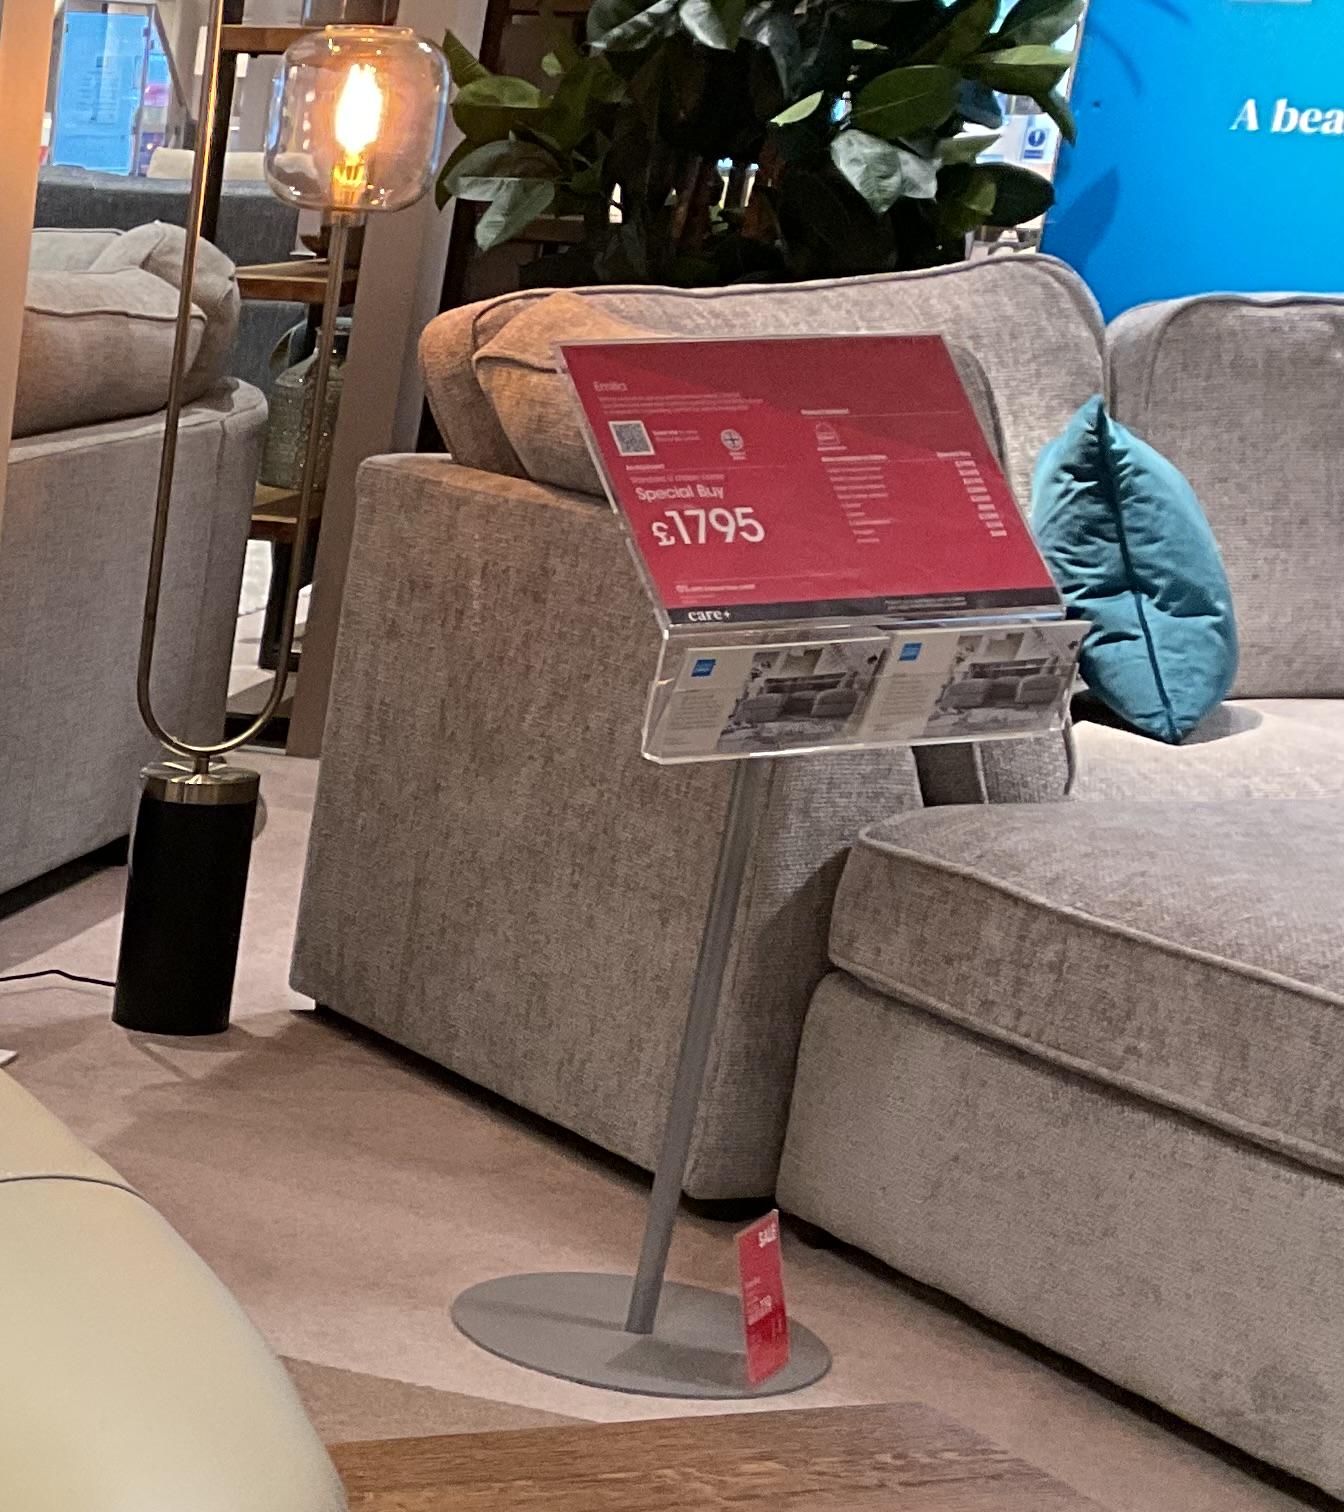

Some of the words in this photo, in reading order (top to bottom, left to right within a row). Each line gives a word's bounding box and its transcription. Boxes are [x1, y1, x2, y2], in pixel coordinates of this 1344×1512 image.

[1229, 97, 1259, 131] A
[635, 484, 694, 503] Special
[696, 484, 725, 499] Buy
[651, 506, 766, 547] £1795
